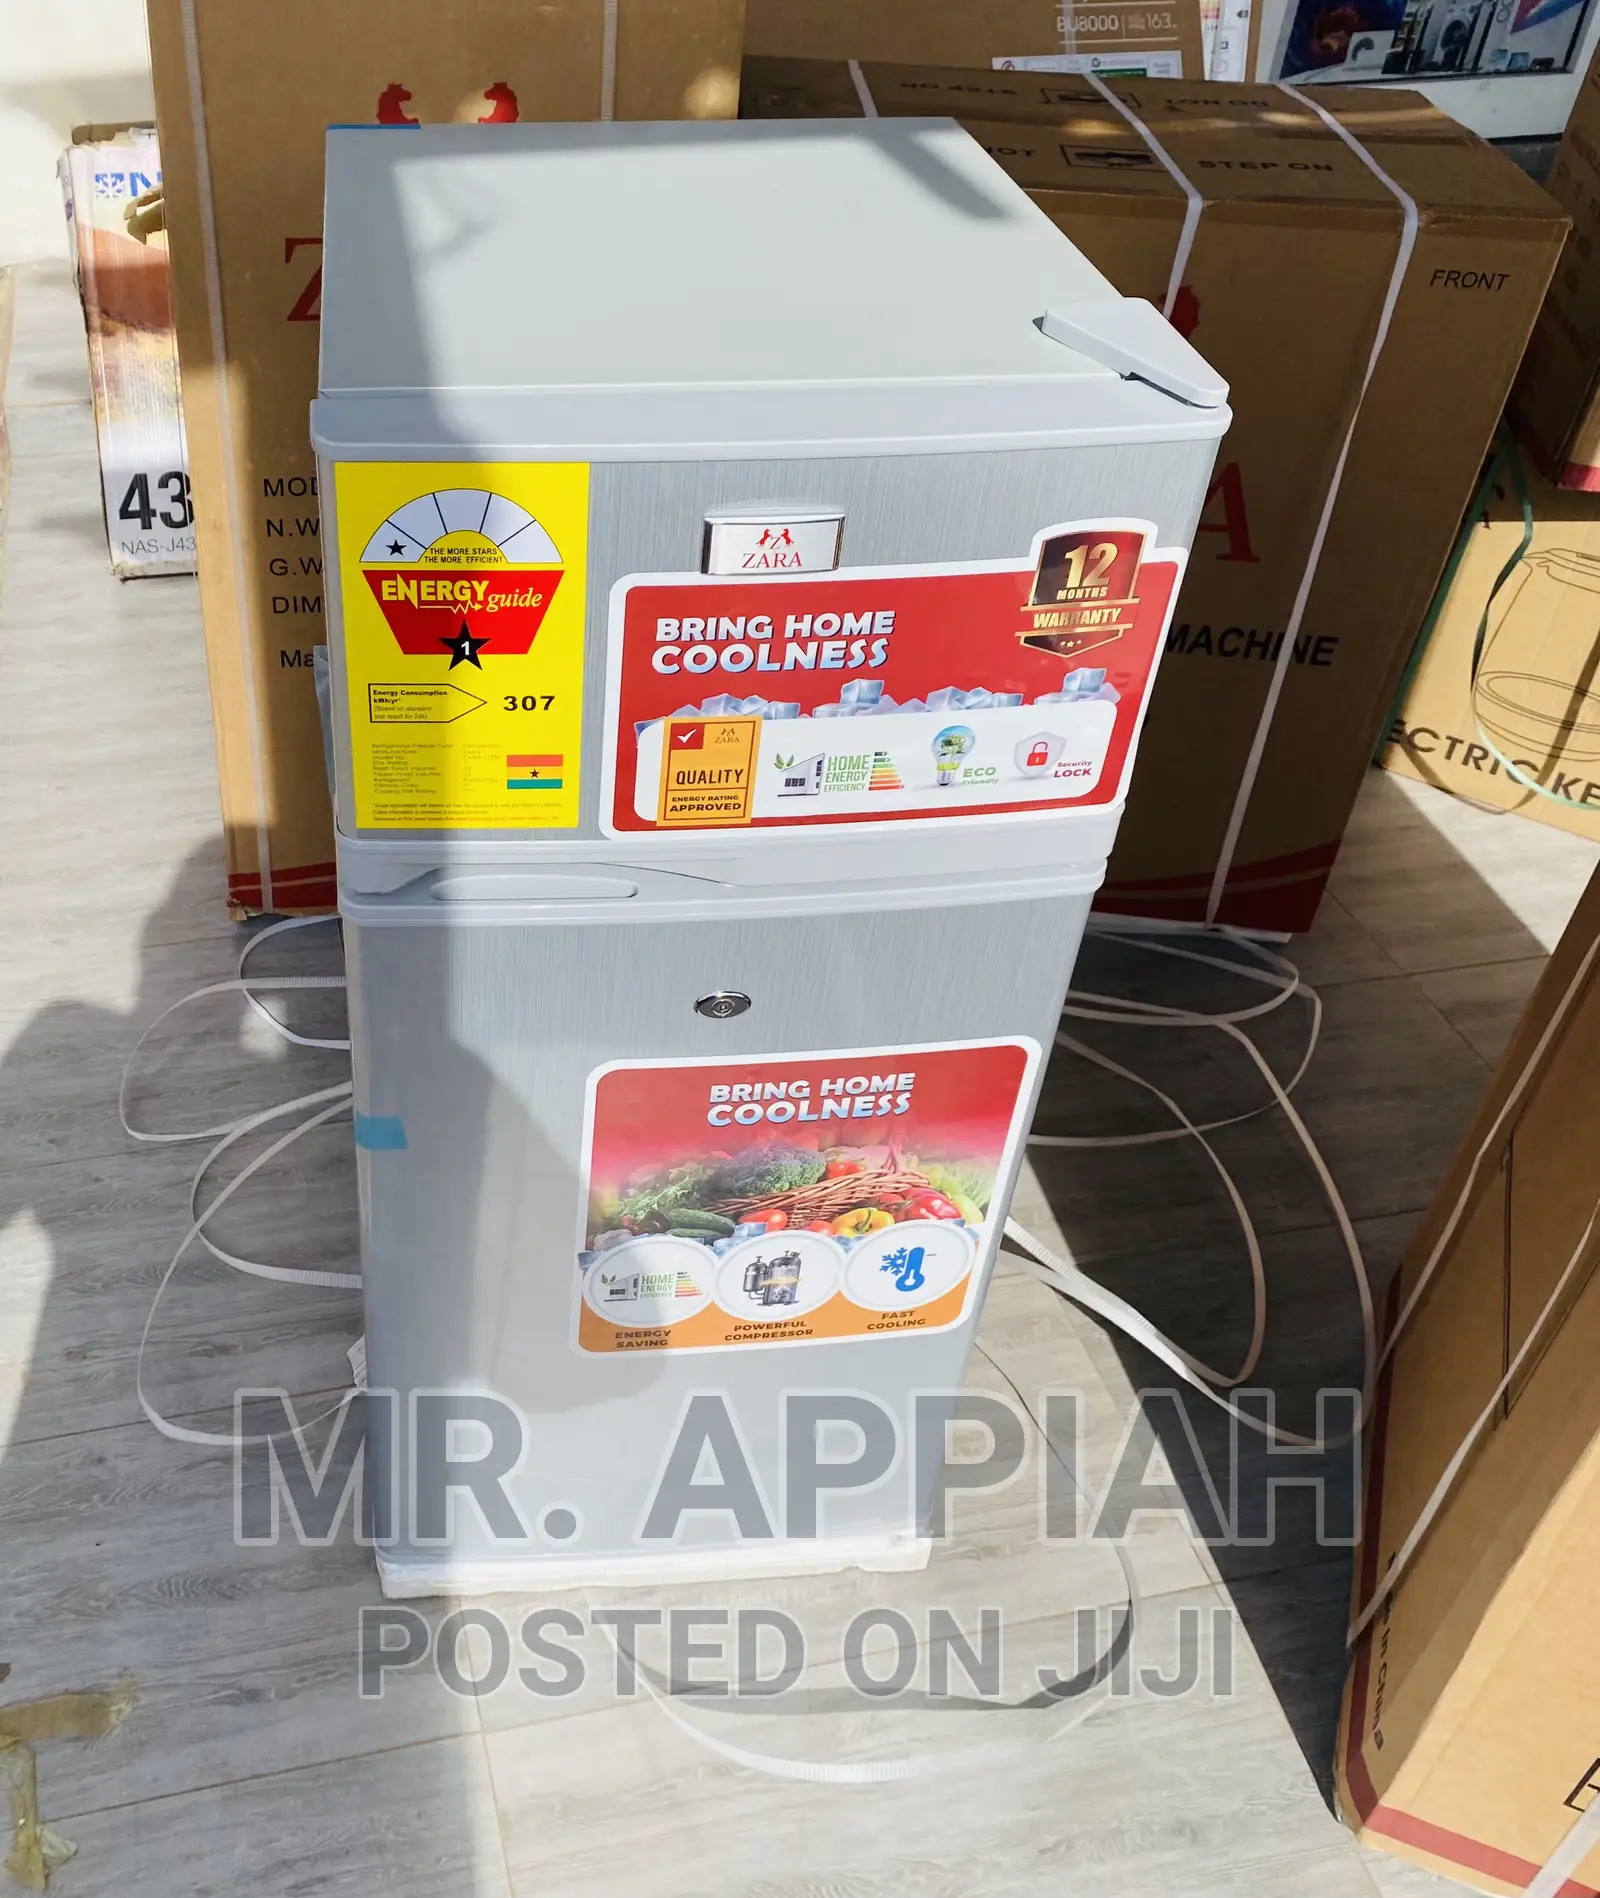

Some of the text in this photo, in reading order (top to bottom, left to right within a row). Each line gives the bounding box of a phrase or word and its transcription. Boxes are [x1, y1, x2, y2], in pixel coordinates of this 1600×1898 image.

[1430, 269, 1511, 290] FRONT
[429, 547, 498, 555] THE MORE STARS
[466, 556, 503, 564] EFFICIENT
[742, 551, 803, 569] ZARA
[1064, 542, 1118, 588] 12
[381, 572, 543, 612] ENERGY guide
[1056, 586, 1108, 600] MONTHS
[1033, 608, 1122, 628] WARRANTY
[656, 610, 896, 642] BRING HOME
[460, 641, 471, 656] 1
[651, 637, 889, 675] COOLNESS
[373, 689, 448, 697] Energy Consumption
[503, 695, 556, 712] 307
[827, 754, 871, 772] HOME
[1057, 760, 1092, 768] Security
[676, 769, 744, 785] QUALITY
[825, 770, 868, 783] ENERGY
[962, 767, 997, 778] ECO
[1053, 767, 1092, 778] LOCK
[962, 777, 999, 786] Friendly
[824, 783, 866, 793] EFFICIENCY
[708, 794, 739, 802] RATING
[669, 802, 742, 813] APPROVED
[709, 1072, 916, 1103] BRING HOME
[707, 1091, 911, 1127] COOLNESS
[641, 1273, 674, 1285] HOME
[640, 1284, 673, 1293] ENERGY
[881, 1310, 916, 1320] FAST
[733, 1320, 807, 1332] POWERFUL
[866, 1318, 926, 1330] COOLING
[615, 1330, 672, 1339] ENERGY
[724, 1329, 813, 1341] COMPRESSOR
[616, 1339, 669, 1348] SAVING
